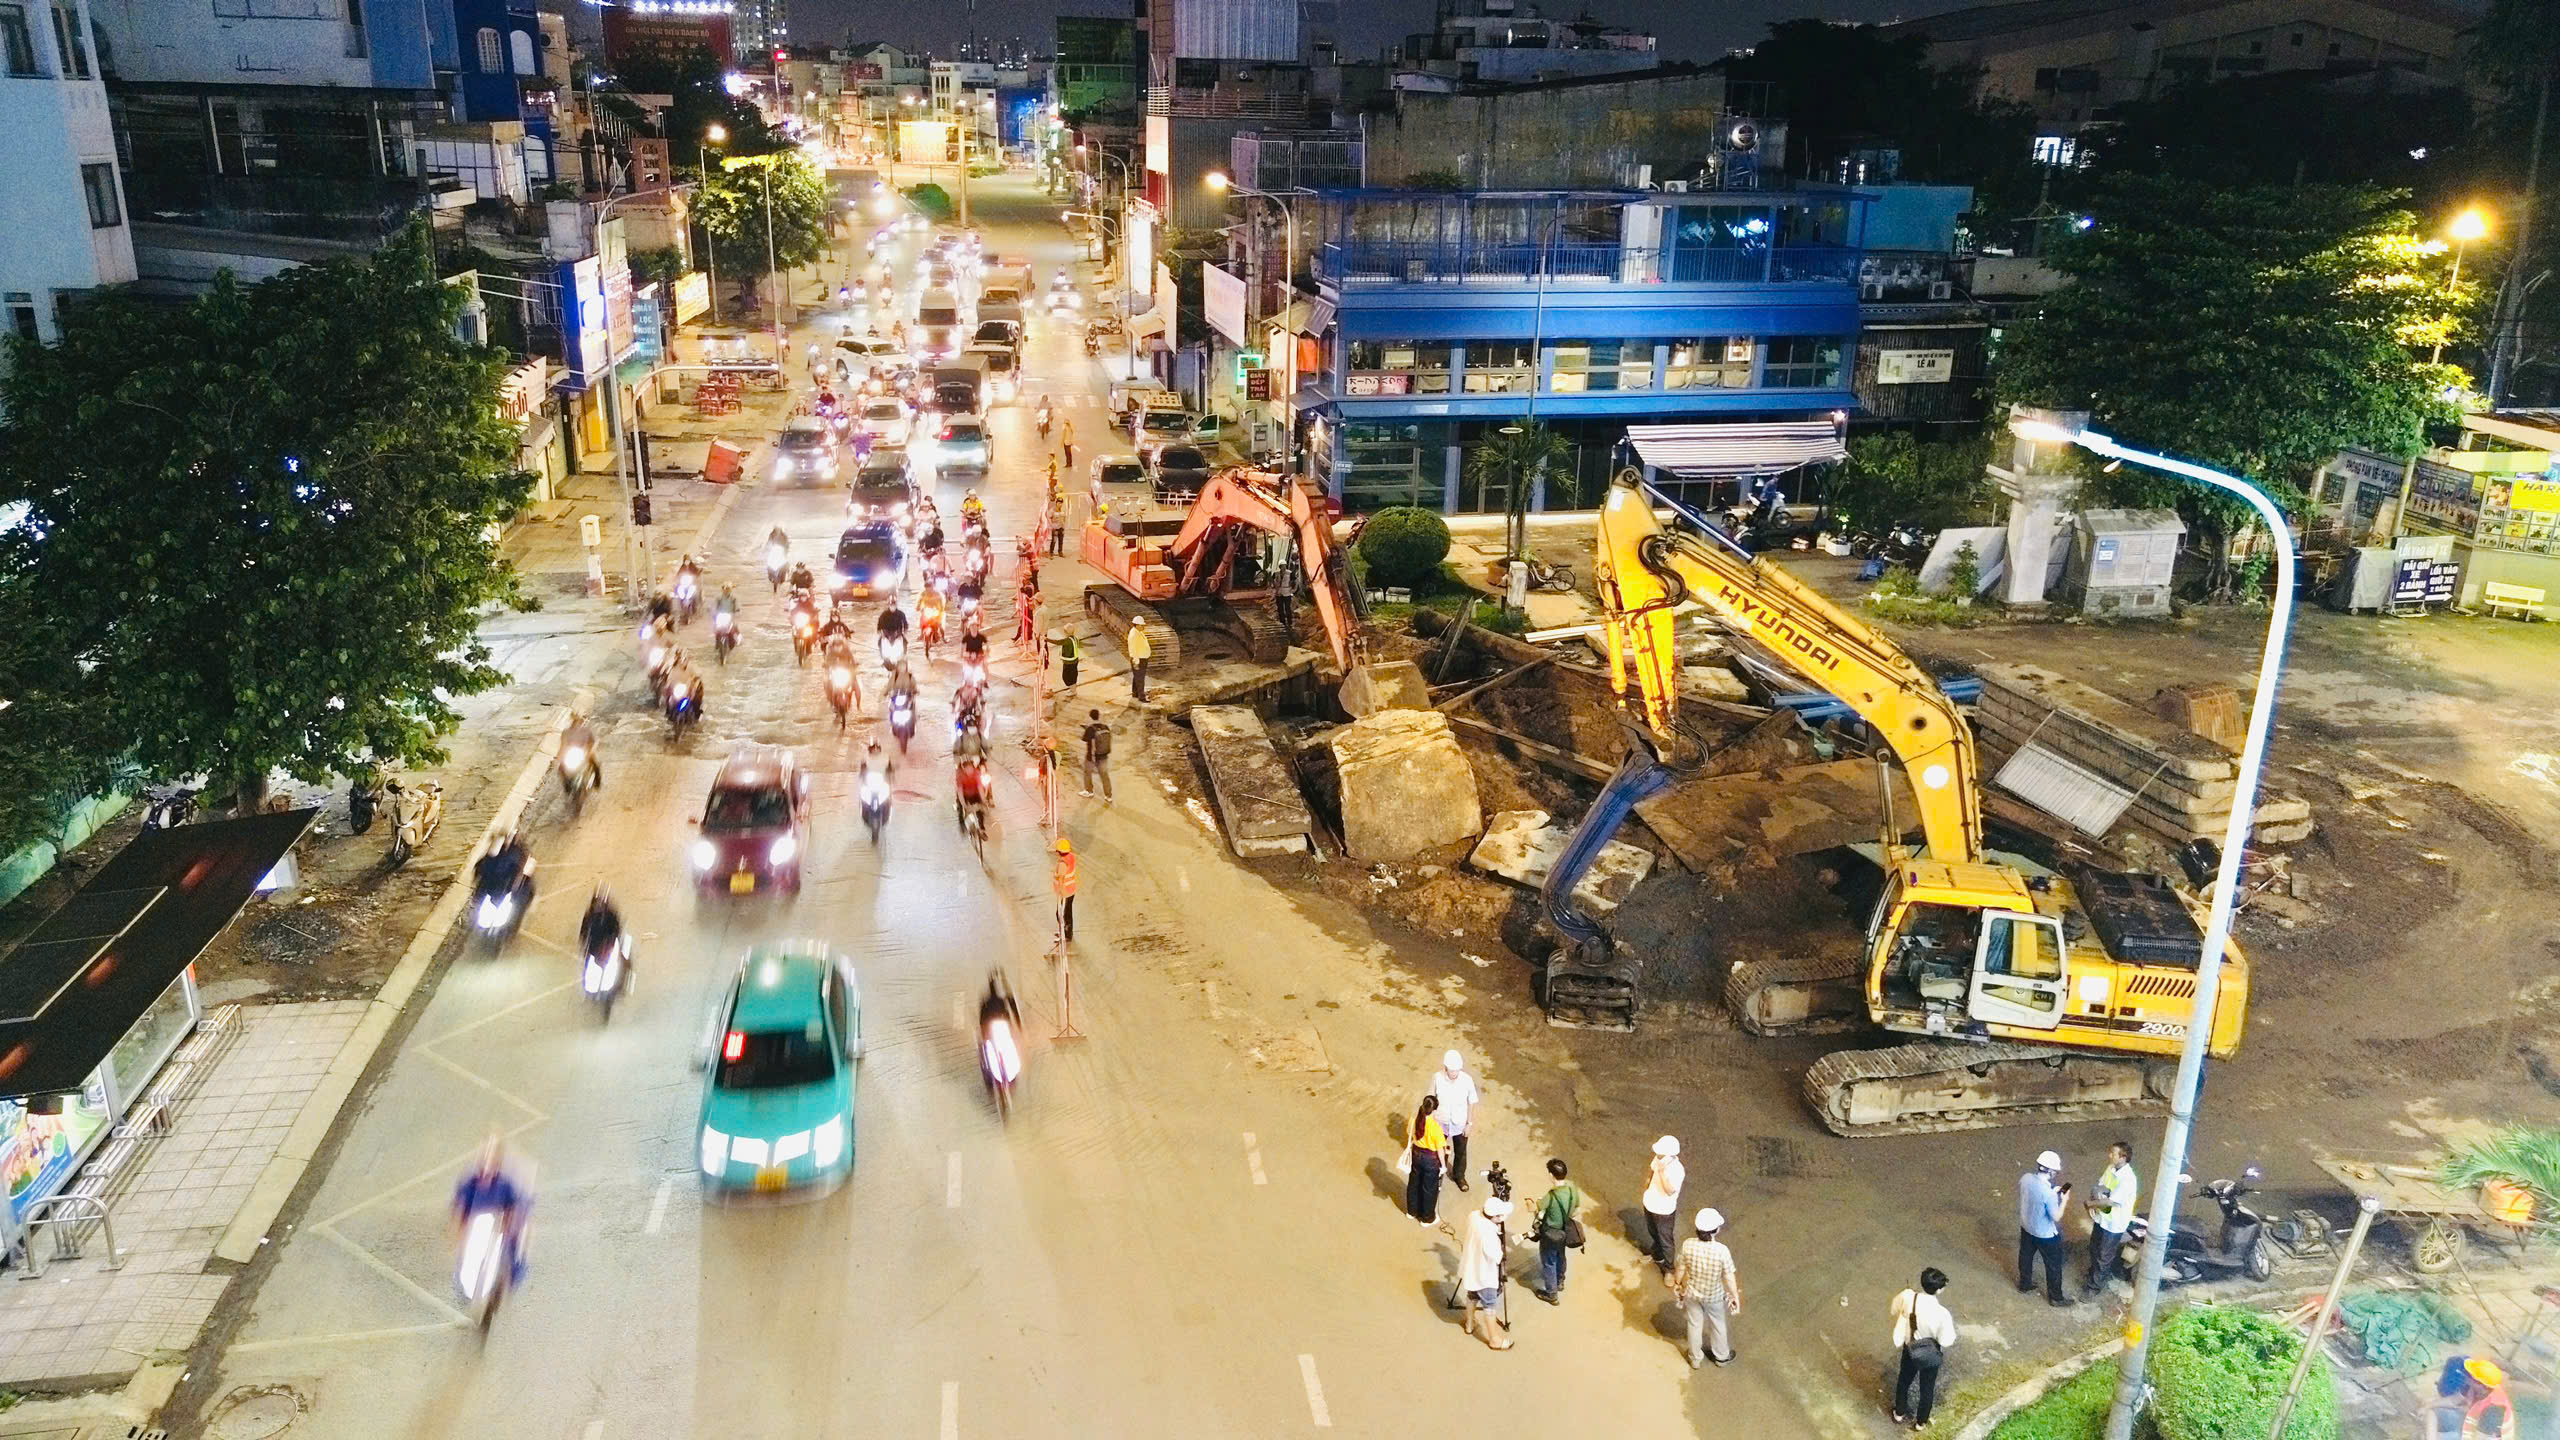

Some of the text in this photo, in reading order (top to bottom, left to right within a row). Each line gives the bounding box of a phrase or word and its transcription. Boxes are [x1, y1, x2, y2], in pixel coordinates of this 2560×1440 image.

[1926, 360, 1936, 368] AN
[2443, 564, 2459, 575] VÀO
[2410, 571, 2421, 579] XE
[2399, 579, 2427, 590] 2 BÁNH
[2444, 576, 2455, 584] XE
[1720, 585, 1840, 671] HYUNDAI
